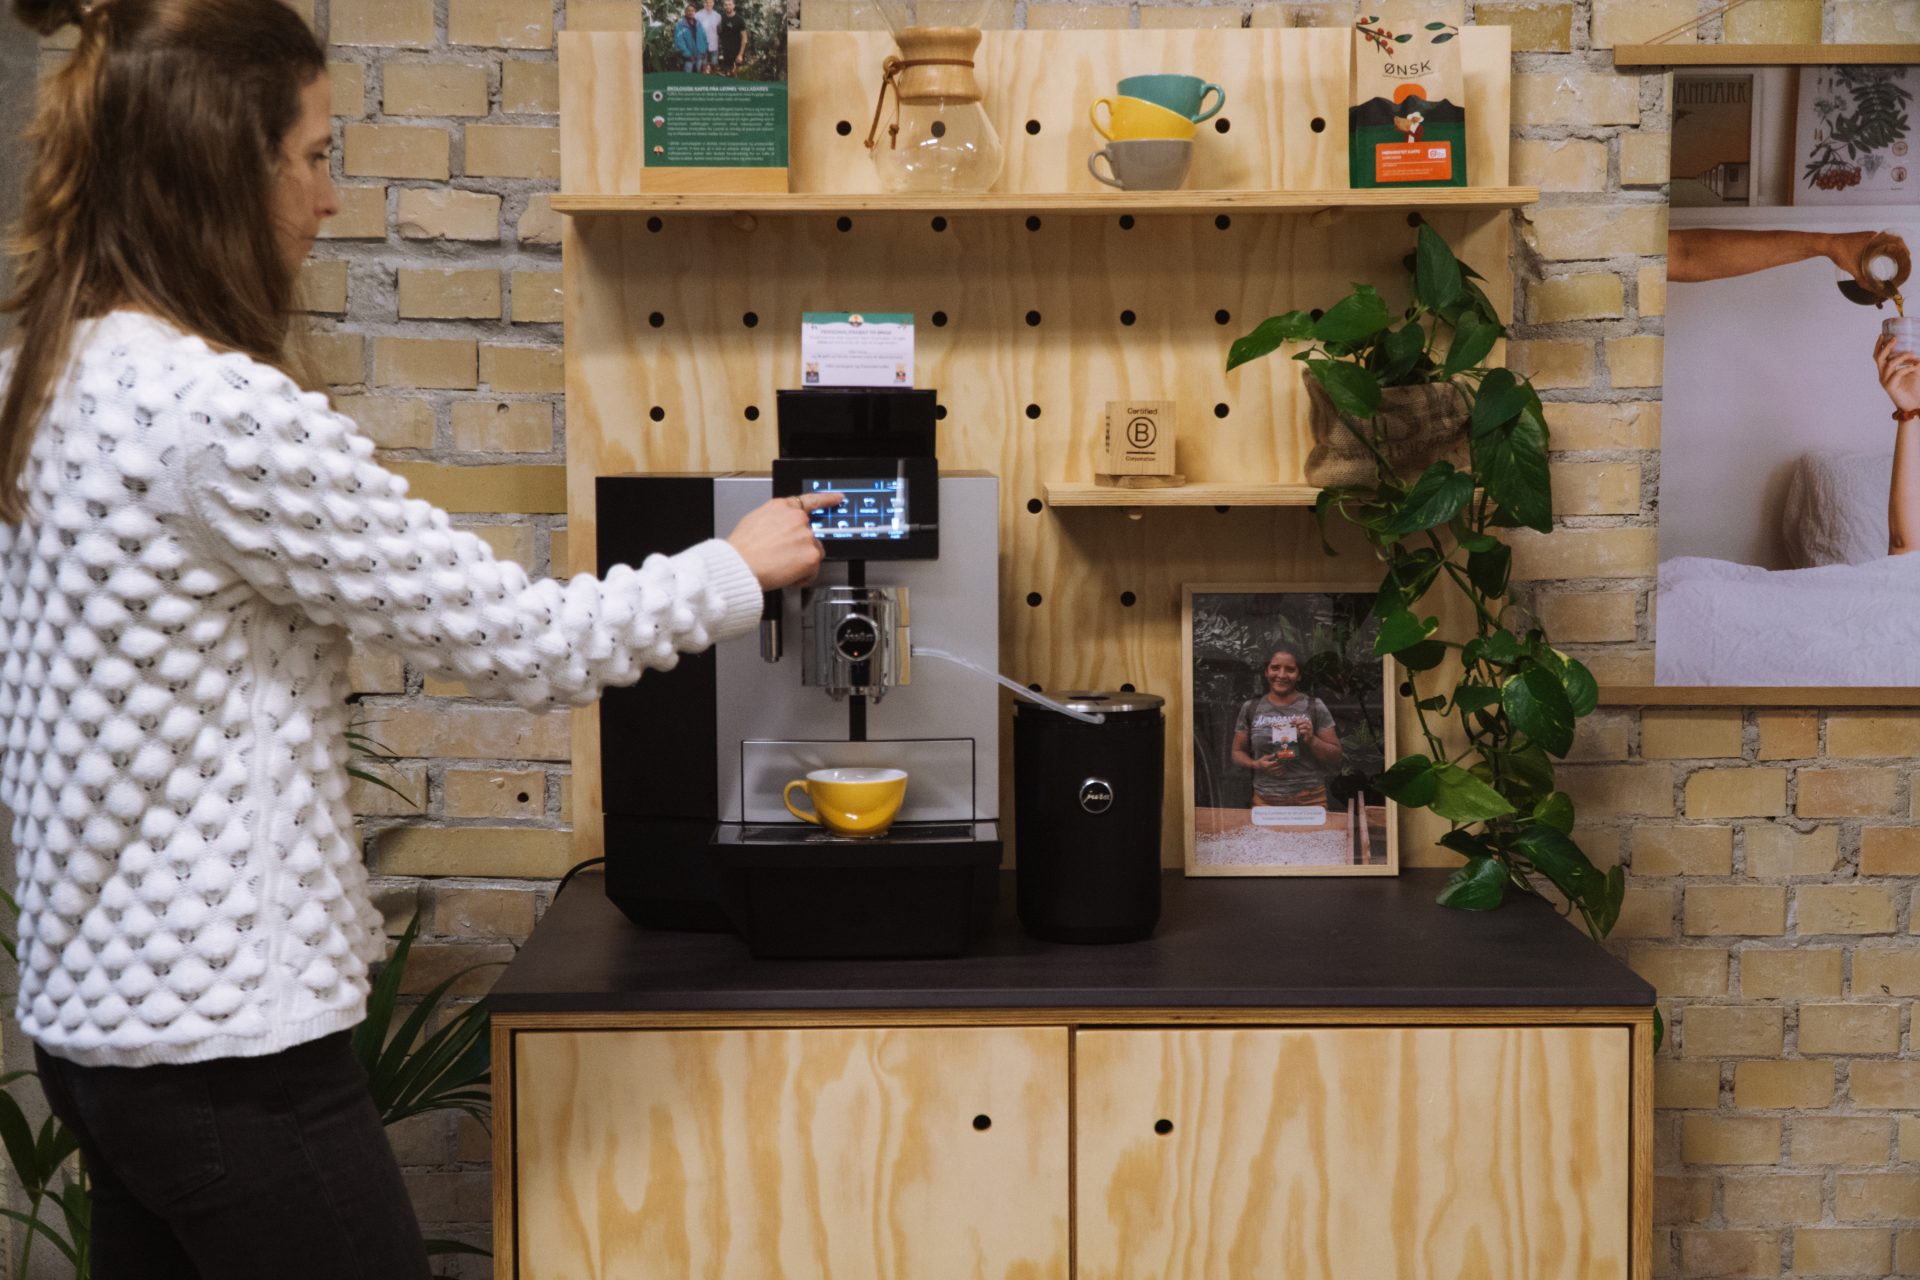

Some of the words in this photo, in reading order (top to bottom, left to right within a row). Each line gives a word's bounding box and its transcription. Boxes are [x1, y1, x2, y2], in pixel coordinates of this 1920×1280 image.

[1384, 59, 1432, 76] ØNSK
[1673, 82, 1746, 104] ANMARK
[1127, 407, 1158, 415] Certified
[1135, 423, 1149, 442] B
